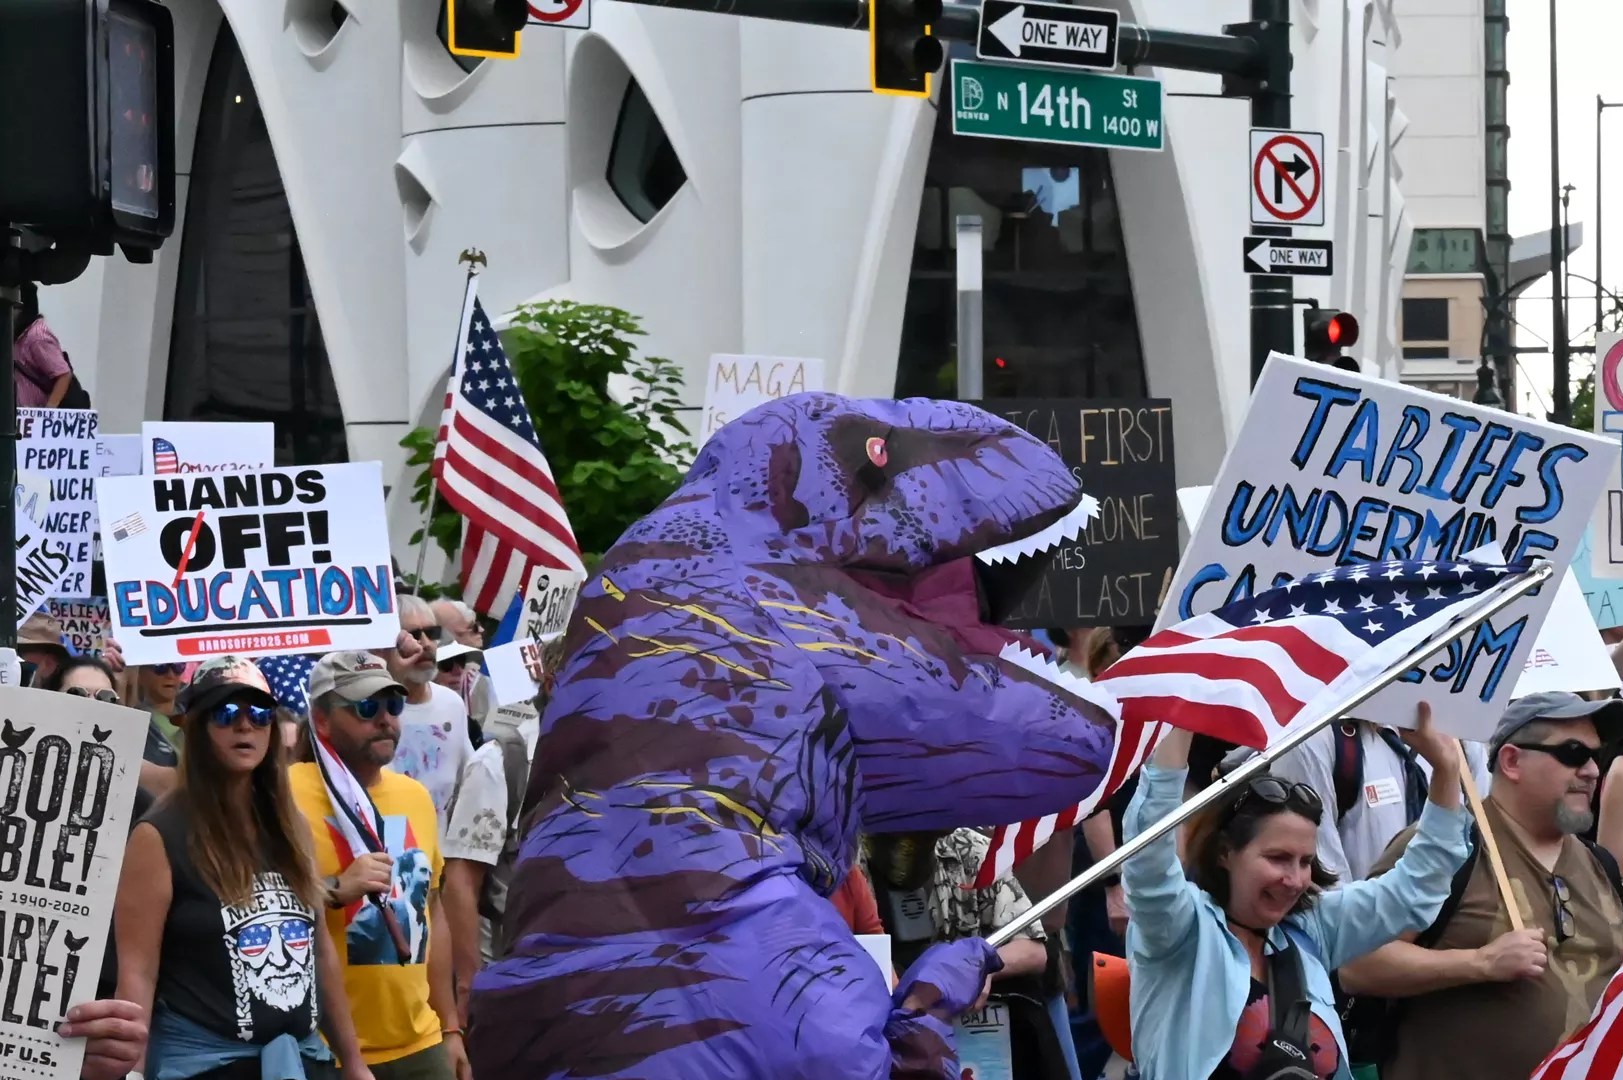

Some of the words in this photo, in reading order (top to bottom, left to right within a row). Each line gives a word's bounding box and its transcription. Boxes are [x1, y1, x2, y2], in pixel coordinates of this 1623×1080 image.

[1022, 22, 1058, 46] ONE
[1066, 26, 1103, 49] WAY
[957, 110, 990, 121] DENVER
[996, 92, 1009, 111] N
[1017, 81, 1092, 130] 14th
[1122, 88, 1138, 109] St
[1103, 115, 1141, 137] 1400
[1146, 119, 1160, 138] W
[1269, 248, 1295, 265] ONE
[1298, 250, 1323, 266] WAY
[715, 361, 805, 398] MAGA
[17, 408, 55, 419] ROUBLE
[41, 418, 98, 440] POWER
[1080, 407, 1171, 465] FIRST
[25, 447, 90, 470] PEOPLE
[1293, 376, 1589, 524] TARIFFS
[153, 469, 326, 512] HANDS
[160, 510, 332, 572] OFF!
[113, 565, 393, 627] EDUCATION
[198, 629, 310, 651] HANDSOFF2025.COM
[11, 892, 90, 917] 1940-2020
[19, 1046, 57, 1068] U.S.
